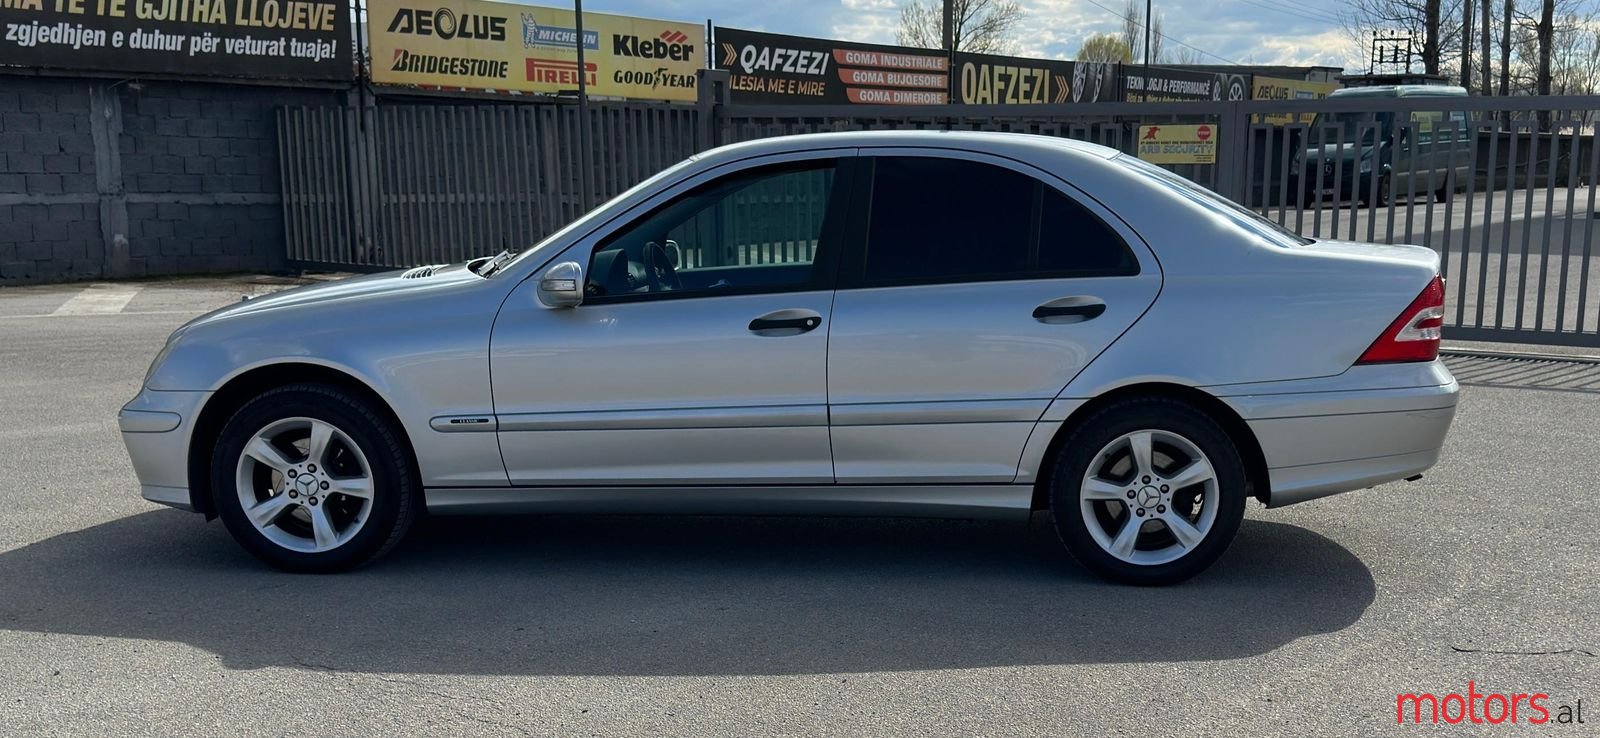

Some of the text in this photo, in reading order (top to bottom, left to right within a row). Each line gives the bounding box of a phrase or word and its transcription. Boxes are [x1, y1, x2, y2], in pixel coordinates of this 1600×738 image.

[235, 0, 336, 31] LLOJEVE
[387, 7, 508, 41] AEOLUS
[6, 21, 337, 62] zgjedhjen e duhur për veturat tuaja!
[538, 29, 597, 45] MICHEIN
[613, 34, 694, 61] Kleber
[391, 49, 508, 78] BRIDGESTONE
[740, 44, 830, 75] QAFZEZI
[846, 52, 943, 69] GOMA INDUSTRIALE
[767, 78, 786, 94] ME
[788, 80, 796, 94] E
[797, 81, 826, 96] MIRE
[853, 71, 885, 84] GOMA
[961, 62, 1050, 104] QAFZEZI
[860, 90, 942, 105] GOMA DIMERORE
